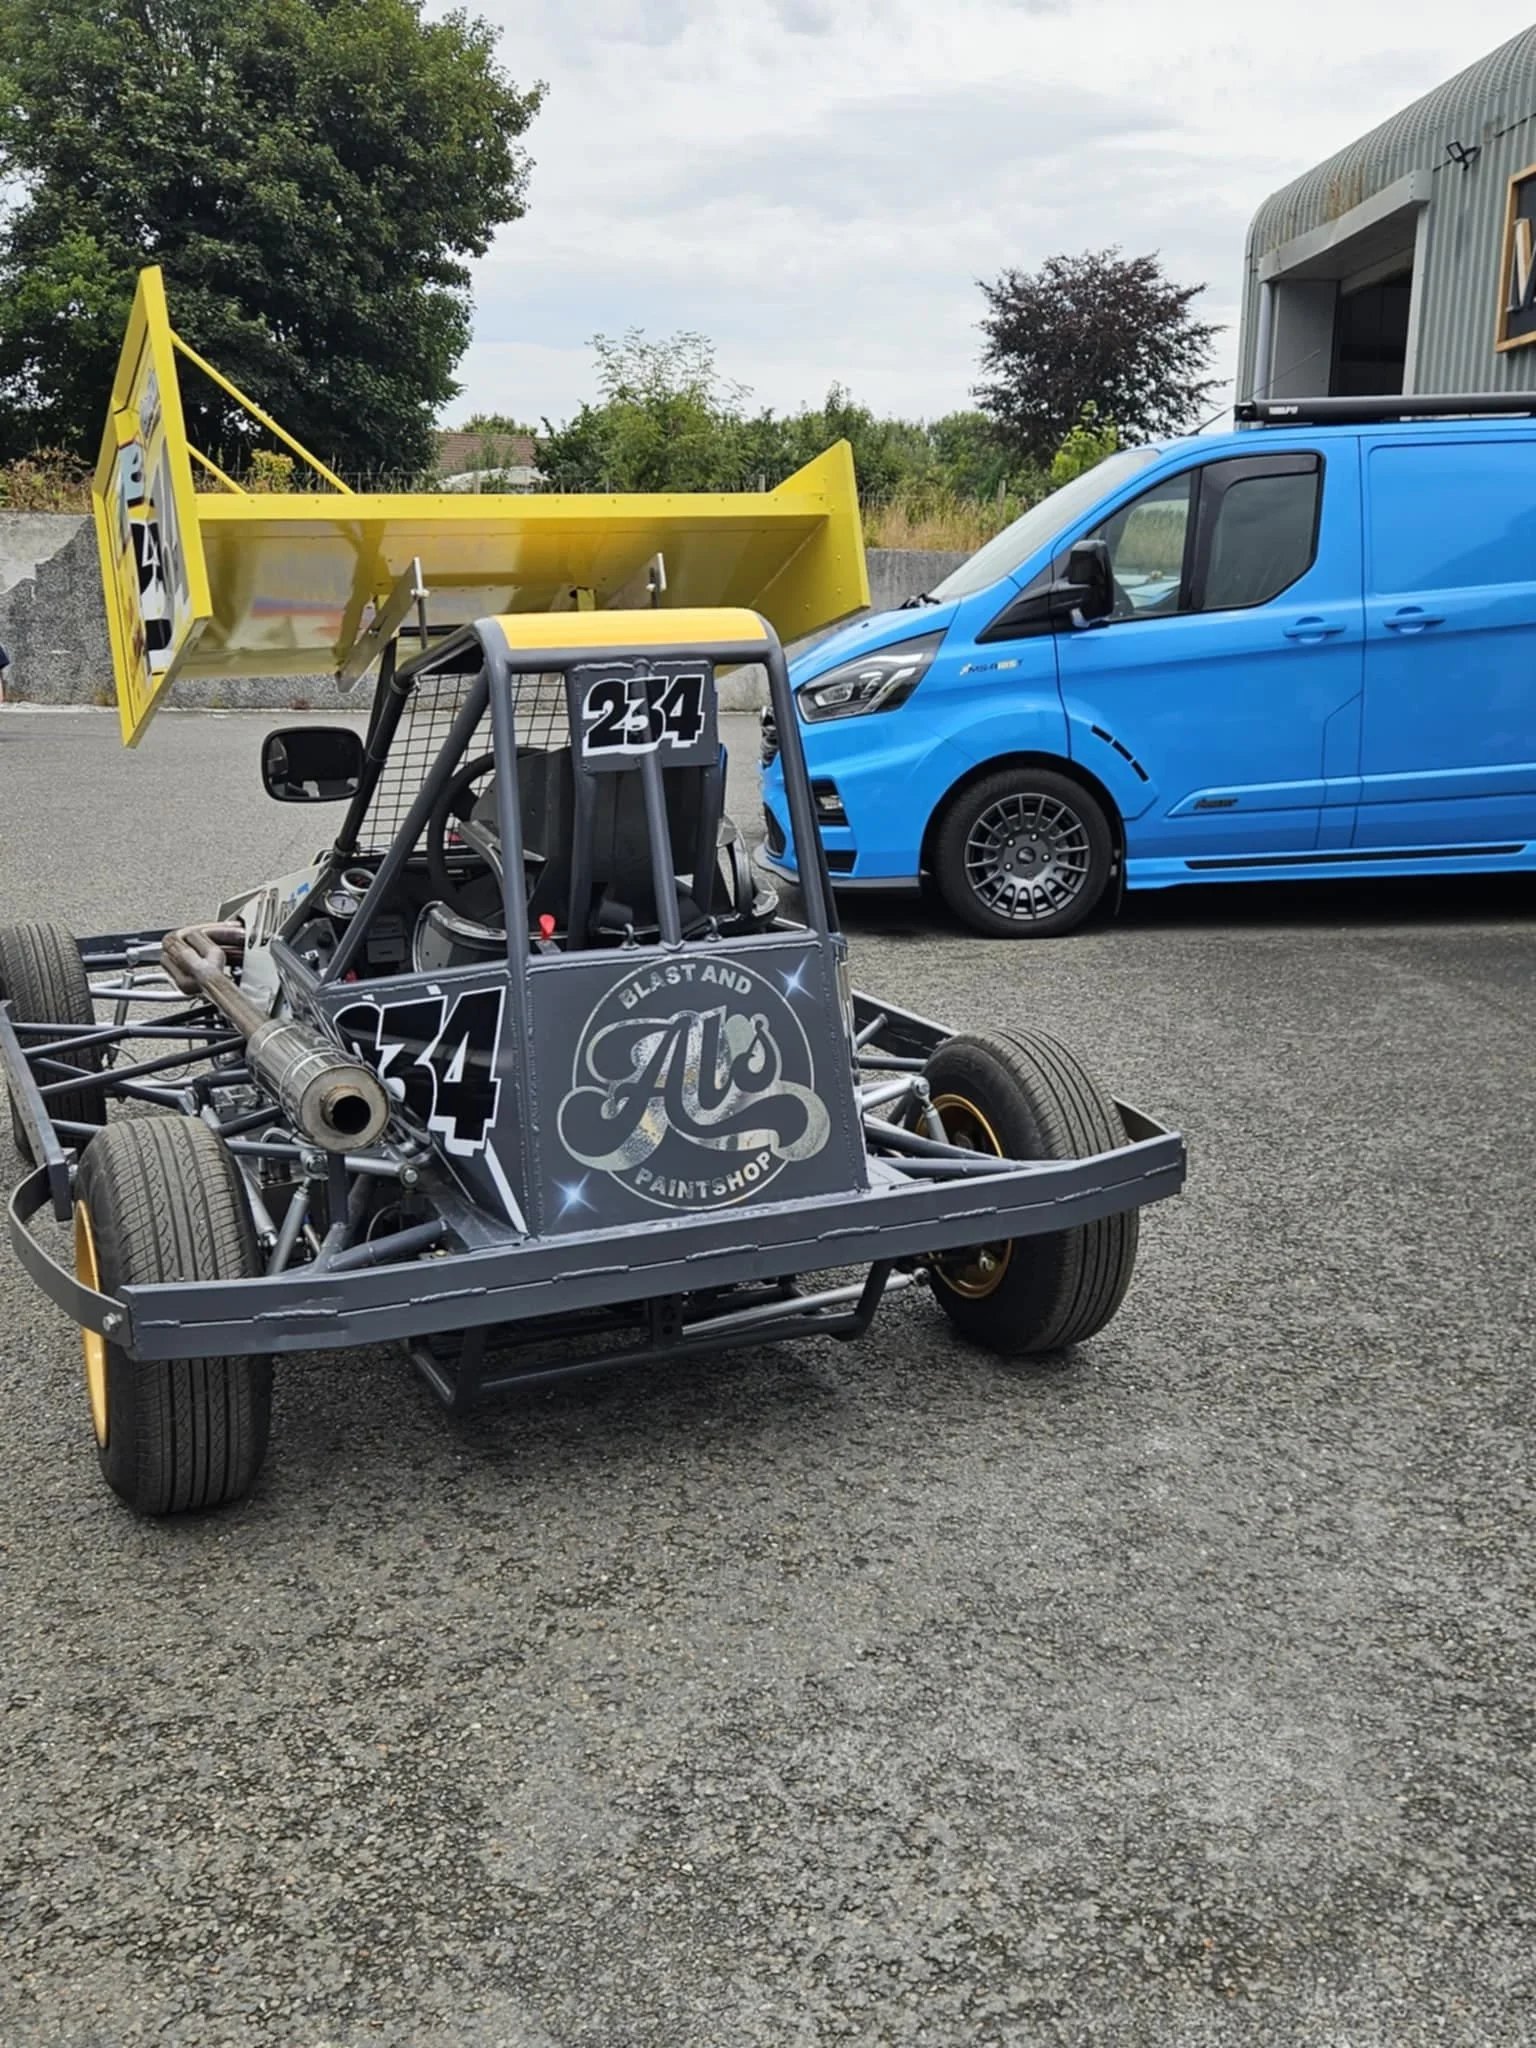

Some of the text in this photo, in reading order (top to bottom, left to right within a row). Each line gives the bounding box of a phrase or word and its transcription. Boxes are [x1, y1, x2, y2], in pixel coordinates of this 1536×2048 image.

[582, 674, 705, 757] 234
[618, 963, 752, 1010] BLAST AND
[634, 1151, 772, 1200] PAINTSHOP
